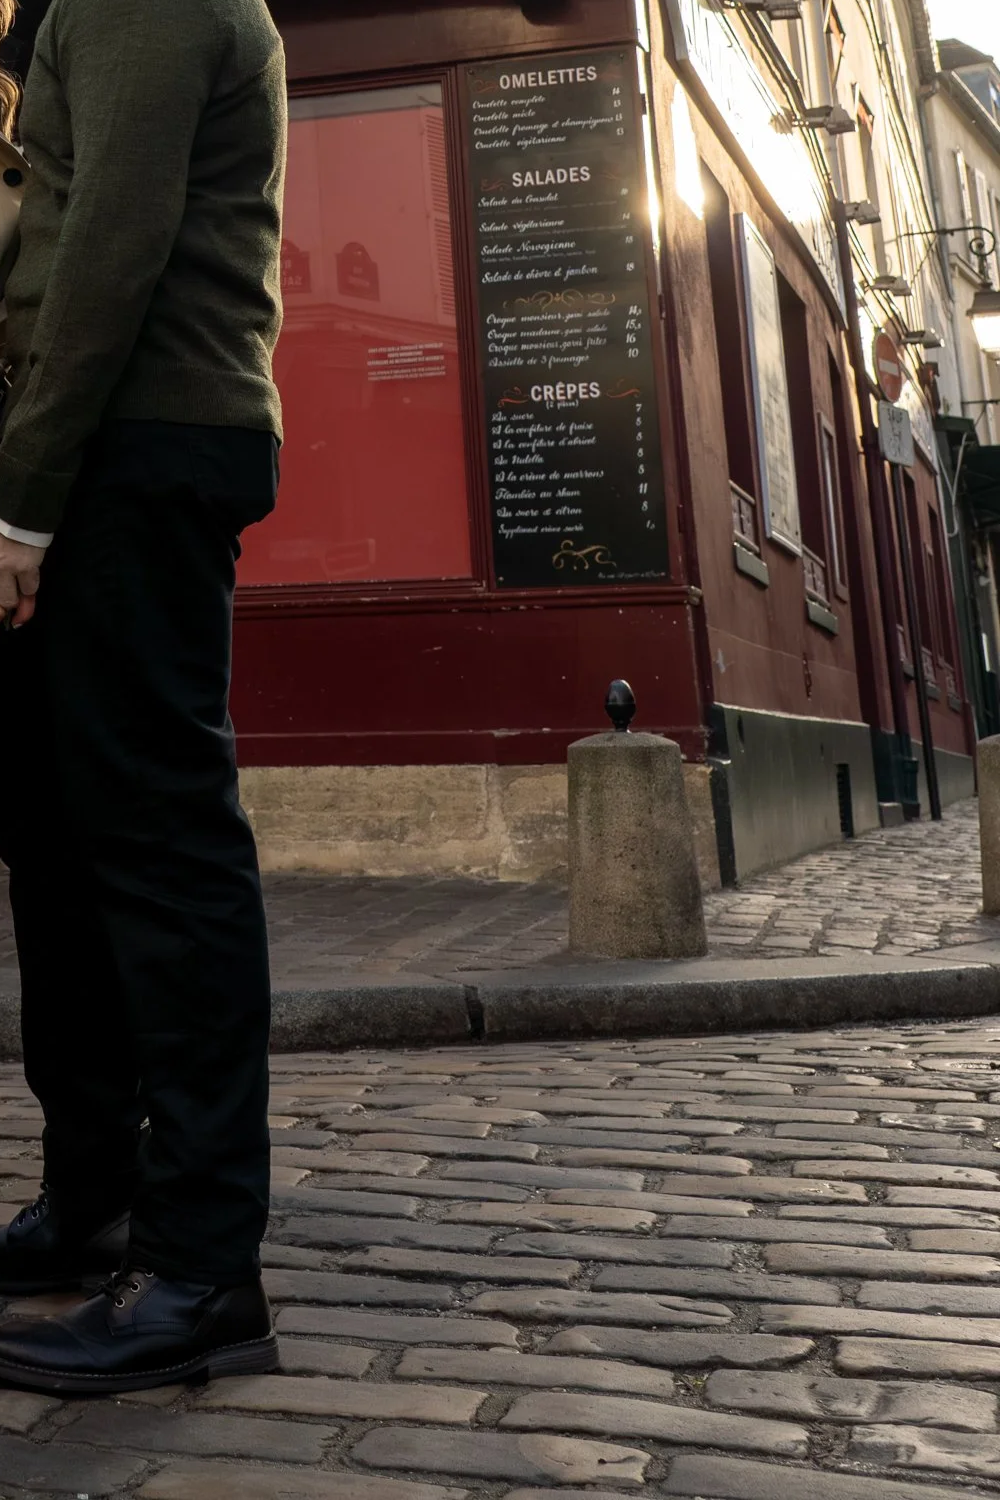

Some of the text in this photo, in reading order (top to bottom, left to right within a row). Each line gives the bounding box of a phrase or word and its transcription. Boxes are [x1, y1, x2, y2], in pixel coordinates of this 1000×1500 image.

[499, 66, 598, 90] OMELETTES
[511, 165, 592, 188] SALADES
[480, 244, 513, 257] Salade
[481, 270, 512, 284] Salade
[563, 264, 598, 282] jambon
[625, 332, 637, 344] 16
[628, 347, 640, 358] 10
[530, 381, 601, 402] CRÊPES
[634, 403, 643, 413] 7
